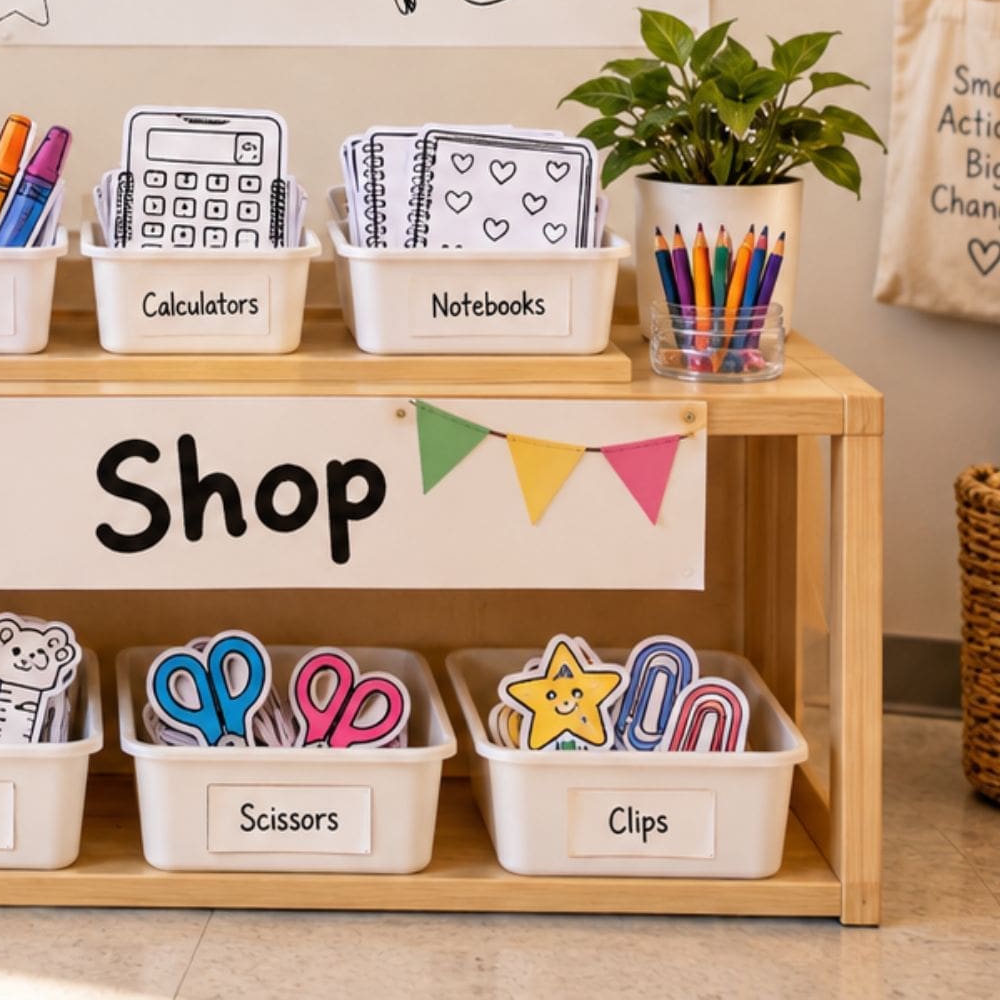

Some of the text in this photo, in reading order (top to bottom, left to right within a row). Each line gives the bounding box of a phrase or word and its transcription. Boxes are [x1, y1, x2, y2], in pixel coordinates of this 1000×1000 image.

[930, 184, 1000, 229] Chan
[142, 290, 259, 318] Calculators
[432, 290, 546, 319] Notebooks
[95, 433, 387, 565] Shop
[240, 802, 339, 833] Scissors
[608, 806, 669, 844] Clips
